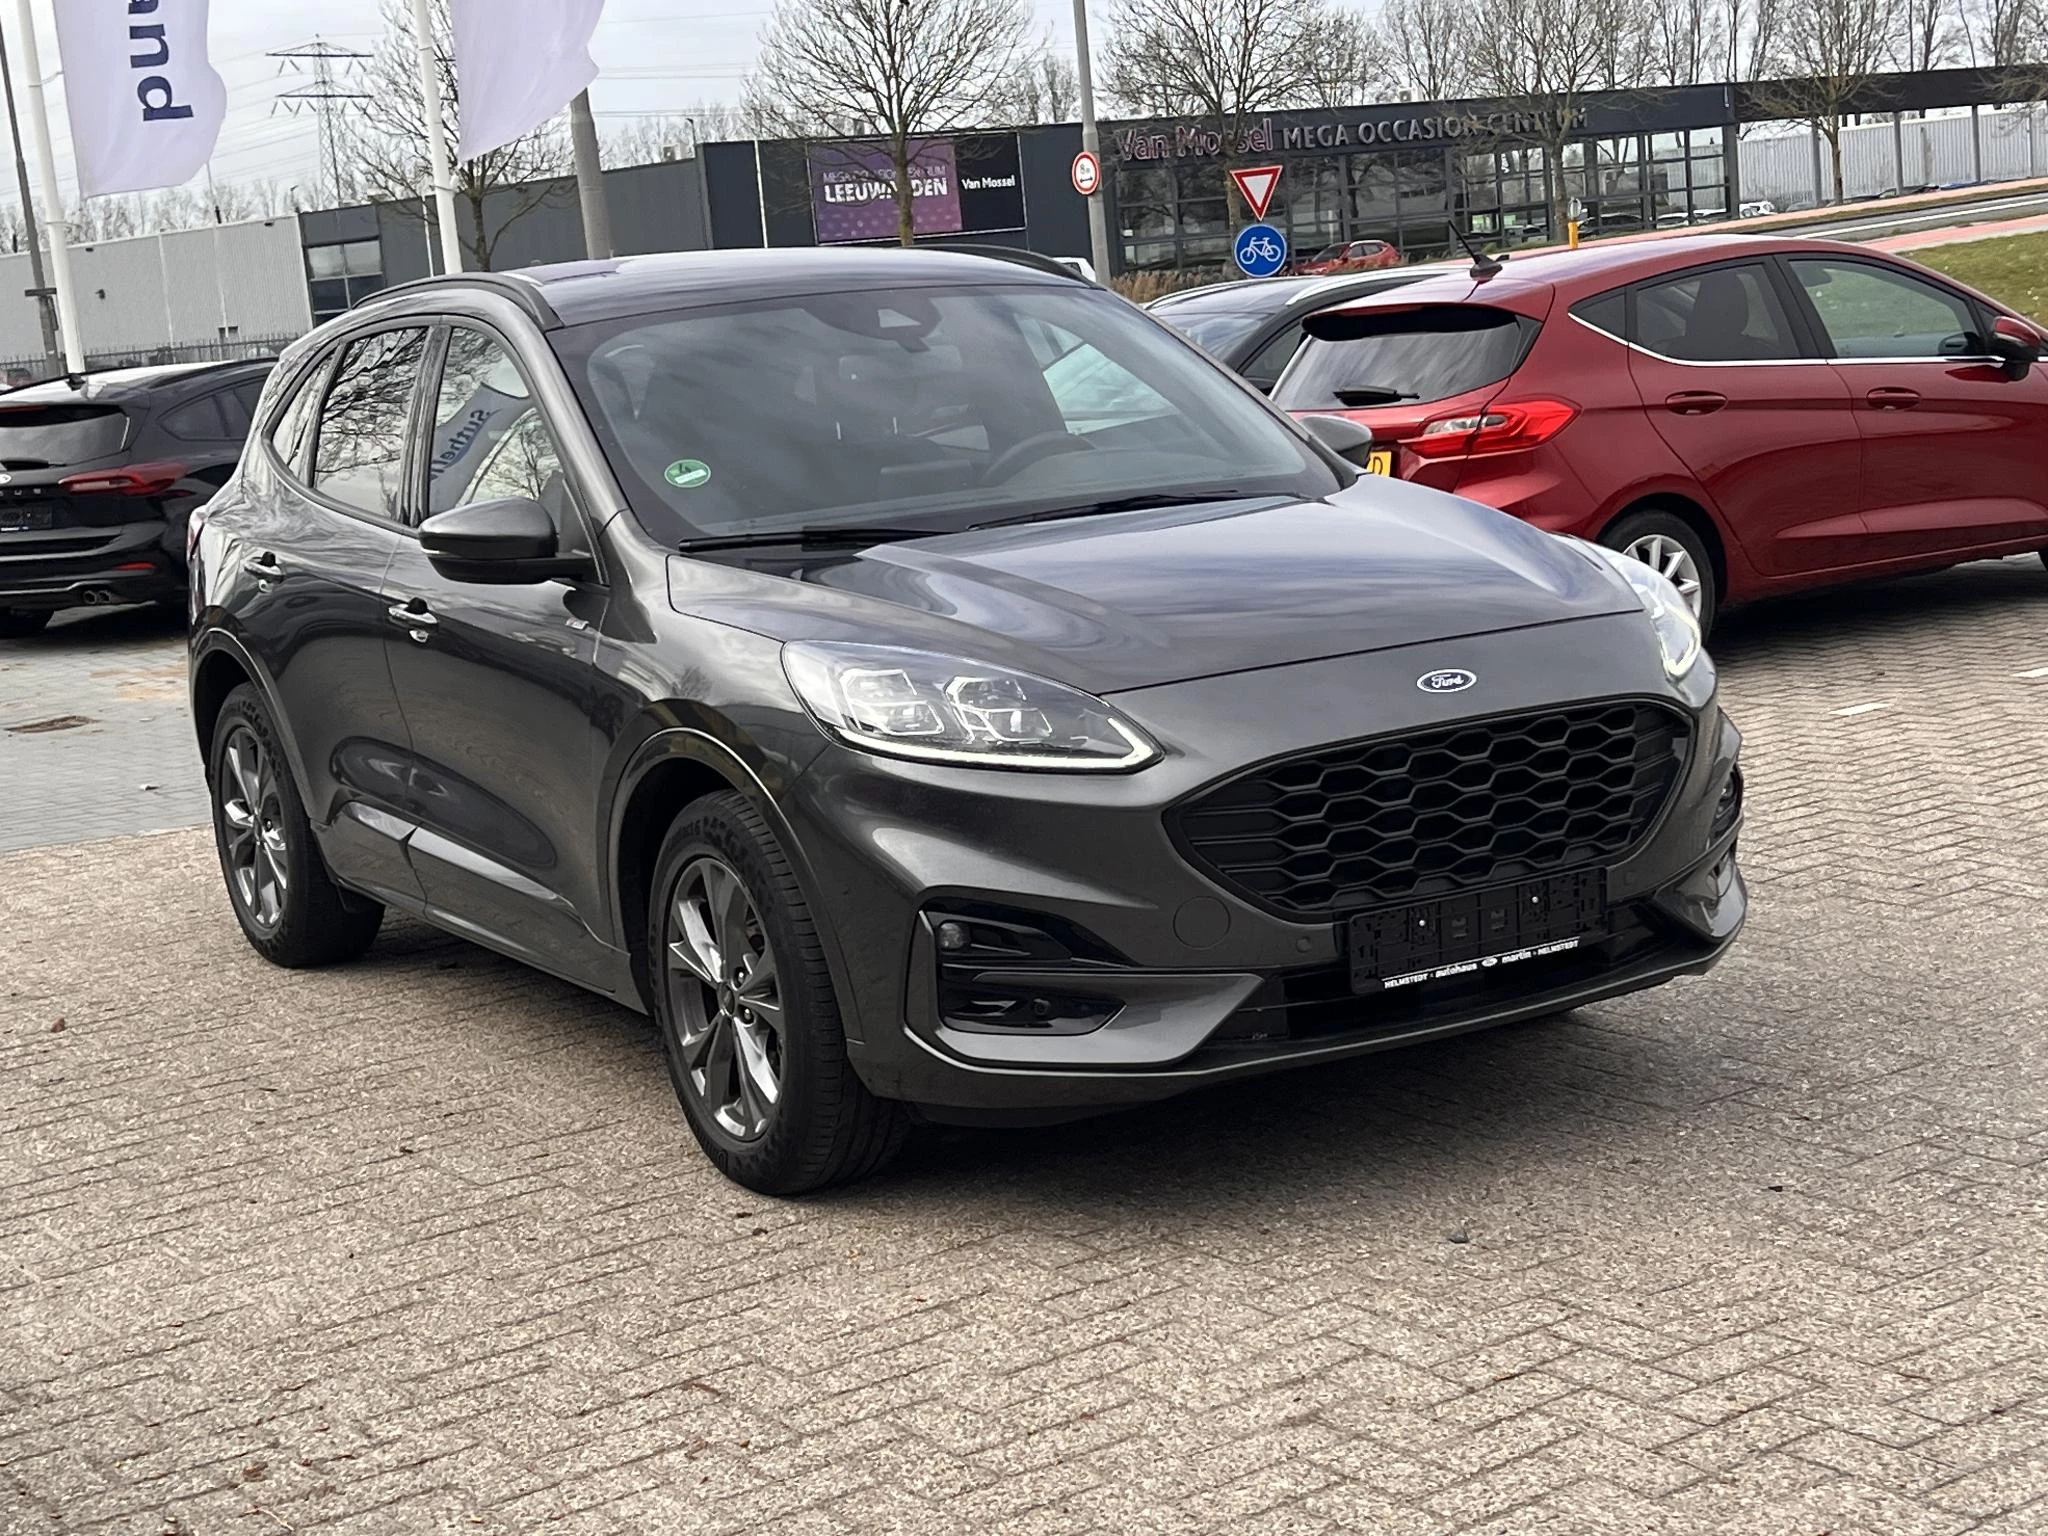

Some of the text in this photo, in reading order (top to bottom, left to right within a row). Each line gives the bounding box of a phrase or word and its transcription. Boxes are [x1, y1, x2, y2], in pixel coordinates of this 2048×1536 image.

[1115, 128, 1170, 160] Van
[1176, 118, 1273, 157] Mosel
[1283, 124, 1350, 150] MEGA
[1358, 113, 1479, 144] OCCASION
[824, 177, 948, 203] LEEUWADEN
[961, 174, 1016, 190] Van Mossel
[1431, 673, 1465, 689] Ford
[1435, 962, 1478, 979] autohaus
[1501, 949, 1532, 965] martin
